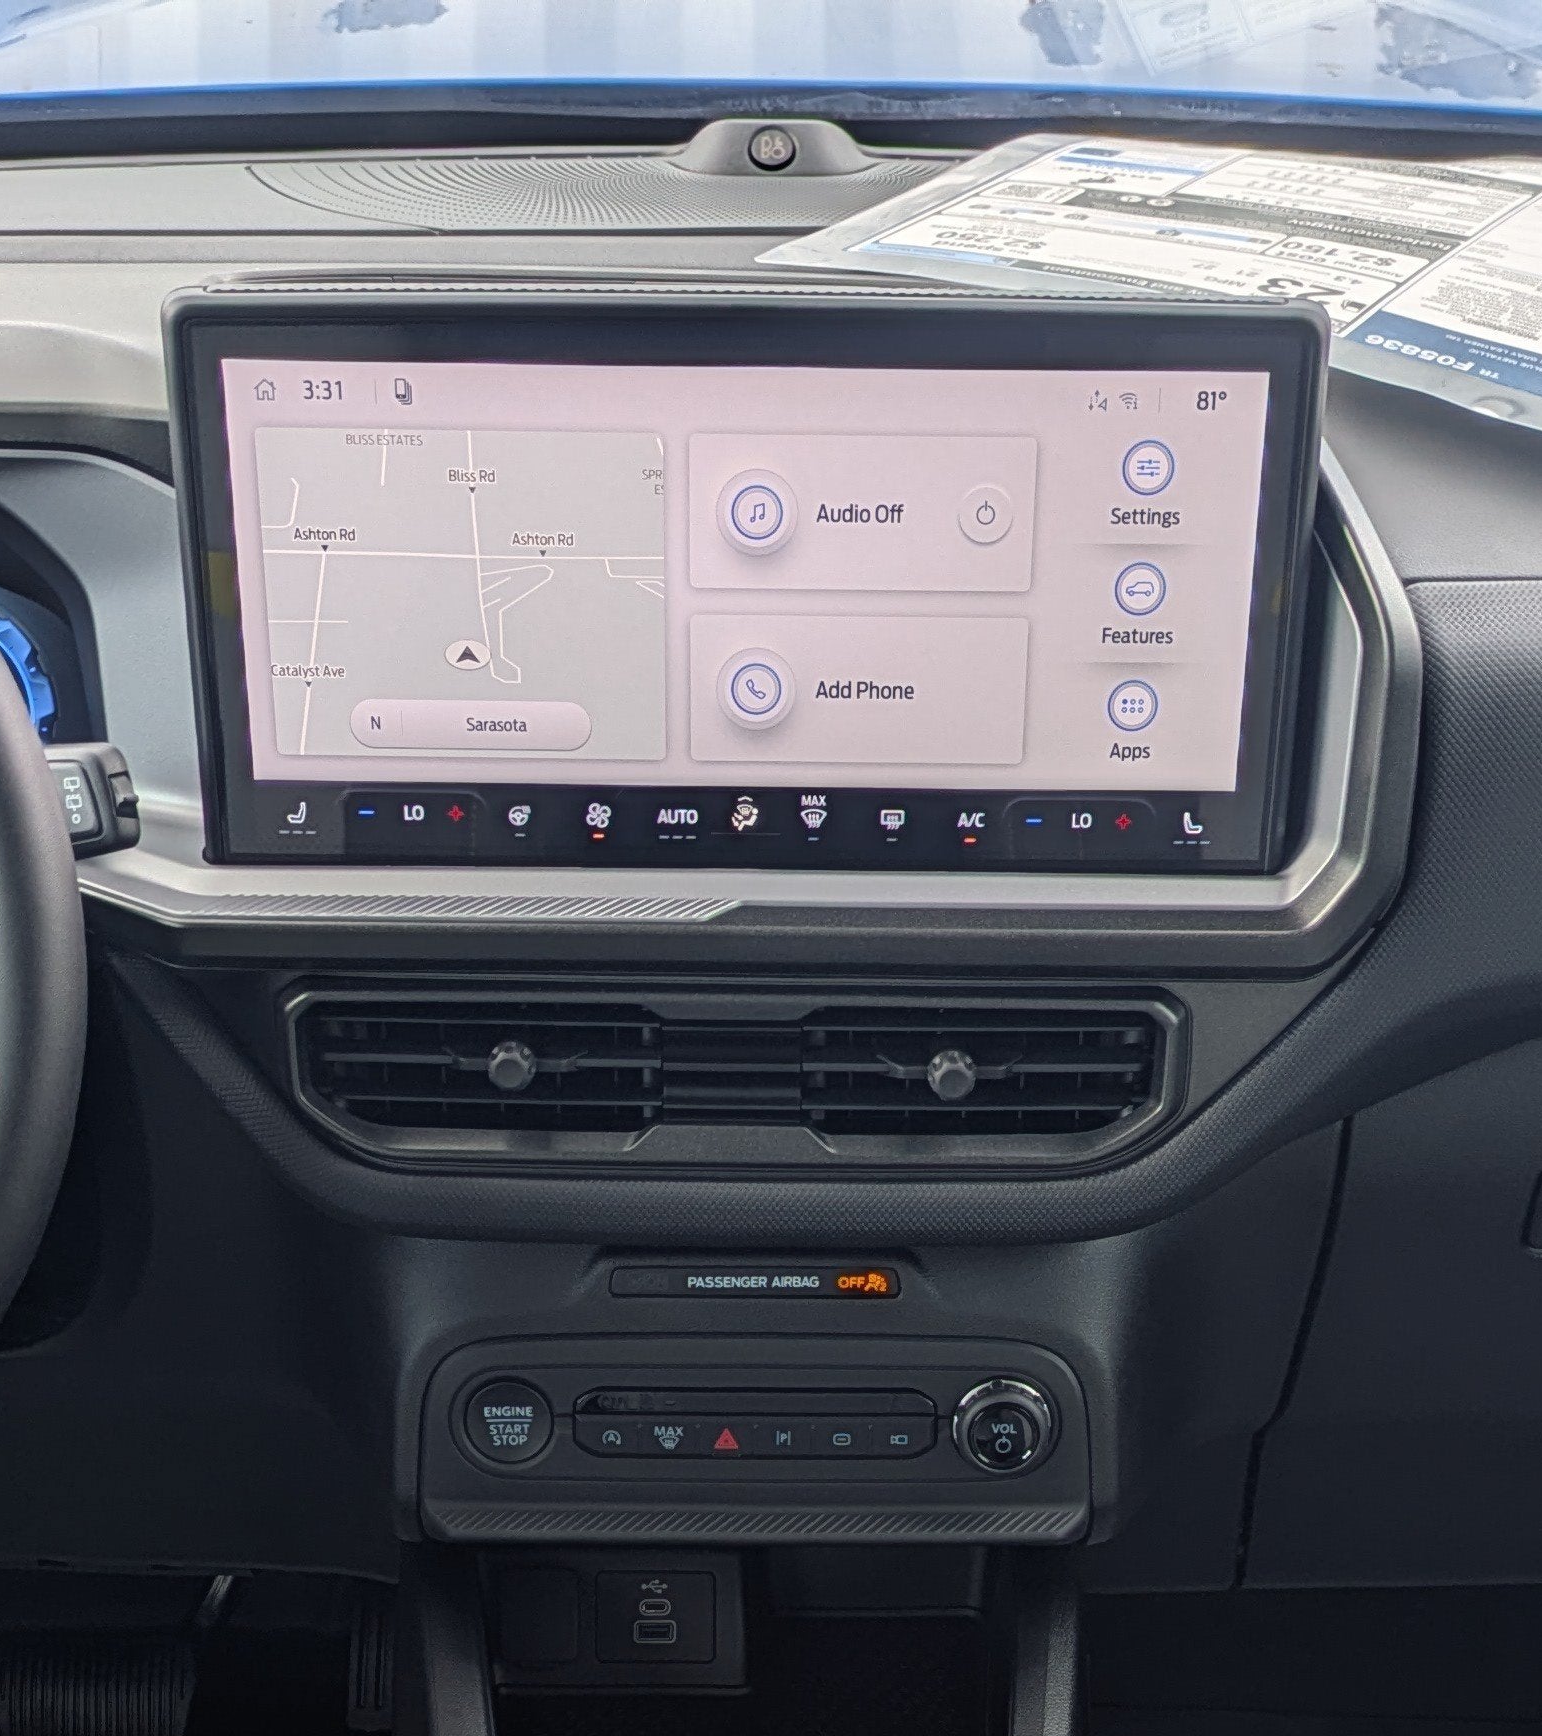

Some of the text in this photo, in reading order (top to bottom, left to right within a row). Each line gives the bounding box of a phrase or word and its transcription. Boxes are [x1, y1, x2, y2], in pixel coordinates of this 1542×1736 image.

[1275, 250, 1327, 264] cost
[1041, 264, 1148, 290] Environment
[1364, 334, 1475, 371] F05836
[301, 378, 346, 403] 3:31
[1196, 390, 1227, 411] 81°
[345, 434, 423, 446] BLISS ESTATES
[448, 469, 496, 483] Bliss Rd
[815, 501, 905, 526] Audio Off
[1110, 507, 1181, 529] Settings
[294, 527, 356, 542] Ashton Rd
[512, 533, 574, 547] Ashton Rd
[1101, 627, 1174, 645] Features
[270, 665, 346, 679] Catalyst Ave
[814, 678, 916, 704] Add Phone
[370, 717, 527, 733] N Sarasota
[1109, 743, 1151, 762] Apps
[800, 794, 828, 808] MAX
[402, 804, 426, 823] LO
[657, 806, 699, 827] AUTO
[957, 811, 986, 832] A/C
[1070, 812, 1093, 831] LO
[687, 1276, 865, 1289] PASSENGER AIRBAG OFF
[483, 1406, 533, 1417] ENGINE
[489, 1424, 530, 1435] START
[653, 1426, 684, 1436] MAX
[991, 1423, 1017, 1434] VOL
[493, 1435, 528, 1446] STOP
